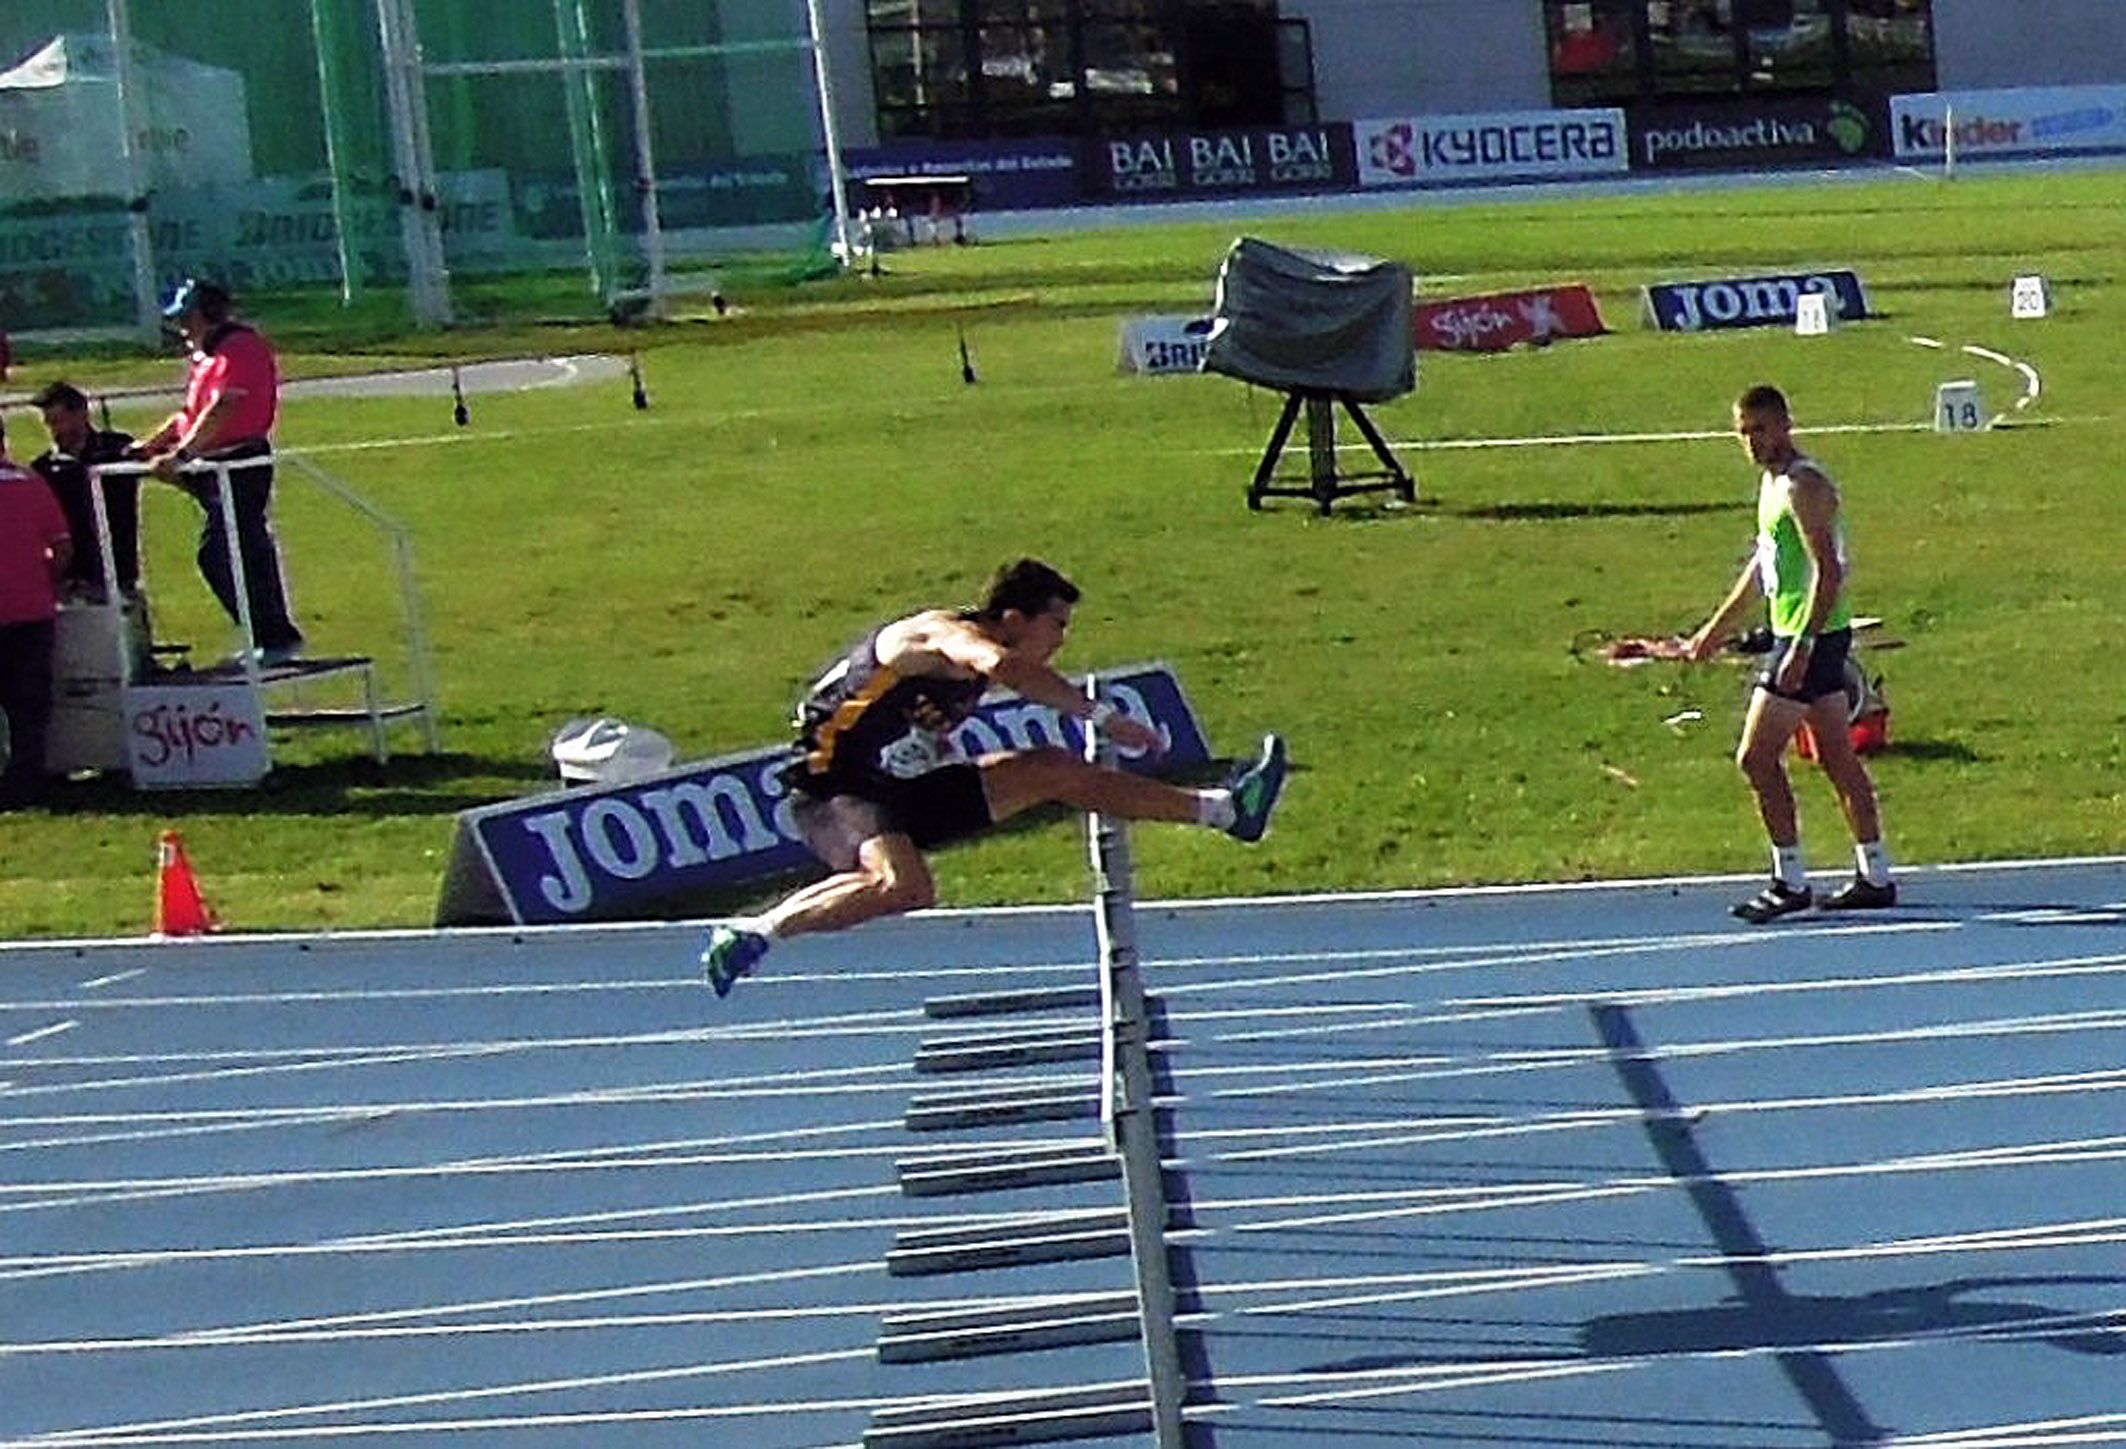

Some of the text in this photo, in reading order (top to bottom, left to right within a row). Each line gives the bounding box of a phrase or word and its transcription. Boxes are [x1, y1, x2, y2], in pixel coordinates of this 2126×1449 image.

[1109, 131, 1330, 174] BAI BAI BAI
[1422, 121, 1615, 167] KYOCERA
[1645, 116, 1816, 164] podoactiva
[1145, 342, 1206, 369] BRI
[1944, 403, 1978, 429] 18
